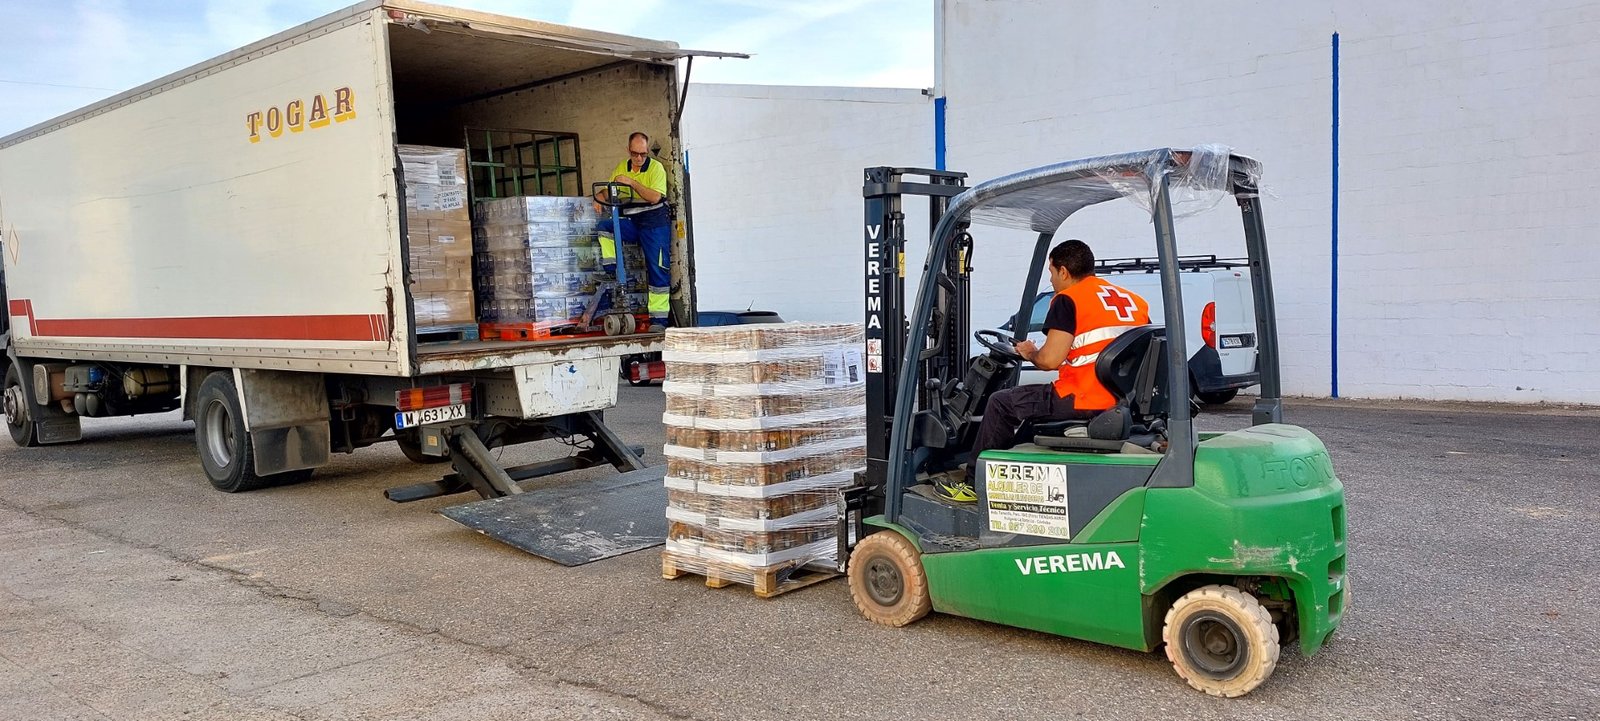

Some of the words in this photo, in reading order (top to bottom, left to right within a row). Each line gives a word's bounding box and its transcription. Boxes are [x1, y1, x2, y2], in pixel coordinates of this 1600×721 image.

[246, 87, 356, 143] TOGAR
[866, 225, 881, 329] VEREMA
[405, 413, 414, 426] M
[987, 464, 1064, 482] VEREMA
[1030, 482, 1044, 495] DE
[1013, 502, 1039, 512] Servicio
[1040, 505, 1065, 514] Técnico
[1014, 551, 1126, 575] VEREMA
